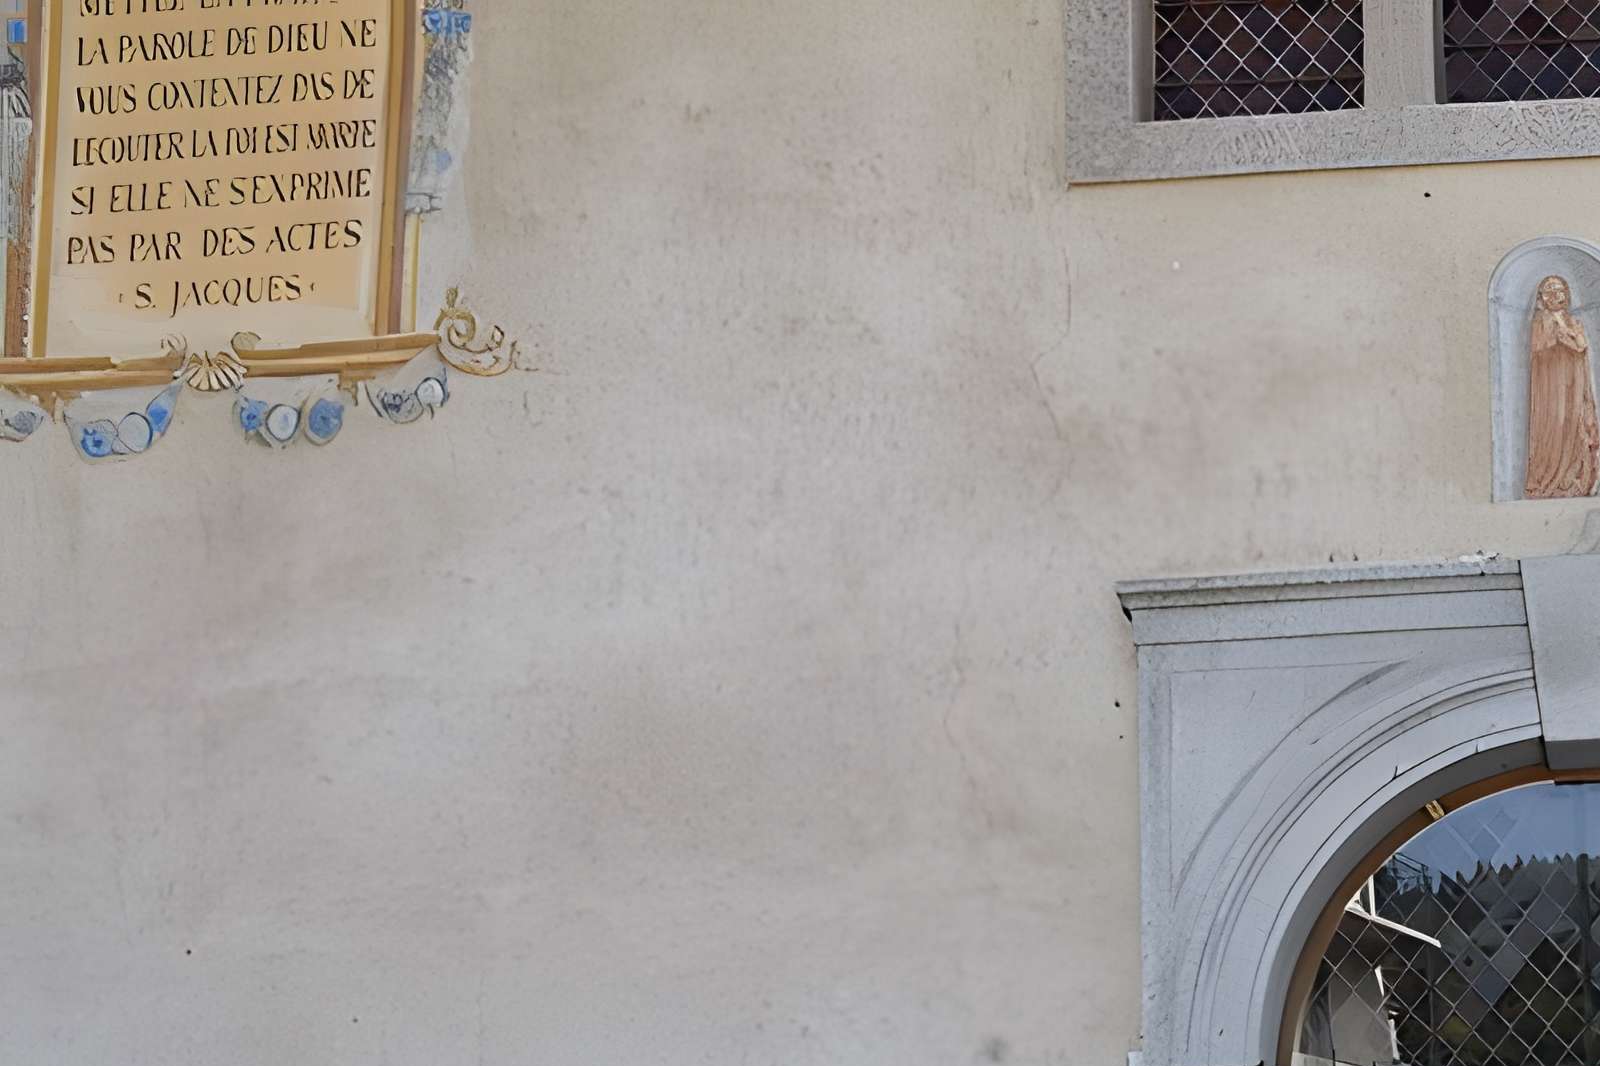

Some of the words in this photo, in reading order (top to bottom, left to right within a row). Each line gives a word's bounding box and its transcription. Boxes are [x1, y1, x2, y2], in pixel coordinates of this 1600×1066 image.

[77, 37, 109, 66] LA
[118, 29, 216, 63] PAROLE
[226, 26, 257, 56] DE
[268, 20, 328, 54] DIEU
[340, 18, 377, 48] NE
[343, 69, 375, 100] DE
[70, 185, 95, 215] SI
[110, 181, 173, 213] ELLE
[184, 178, 220, 209] NE
[67, 234, 116, 265] PAS
[129, 231, 182, 262] PAR
[203, 226, 256, 257] DES
[265, 219, 363, 254] ACTES
[169, 273, 301, 319] JACQUES
